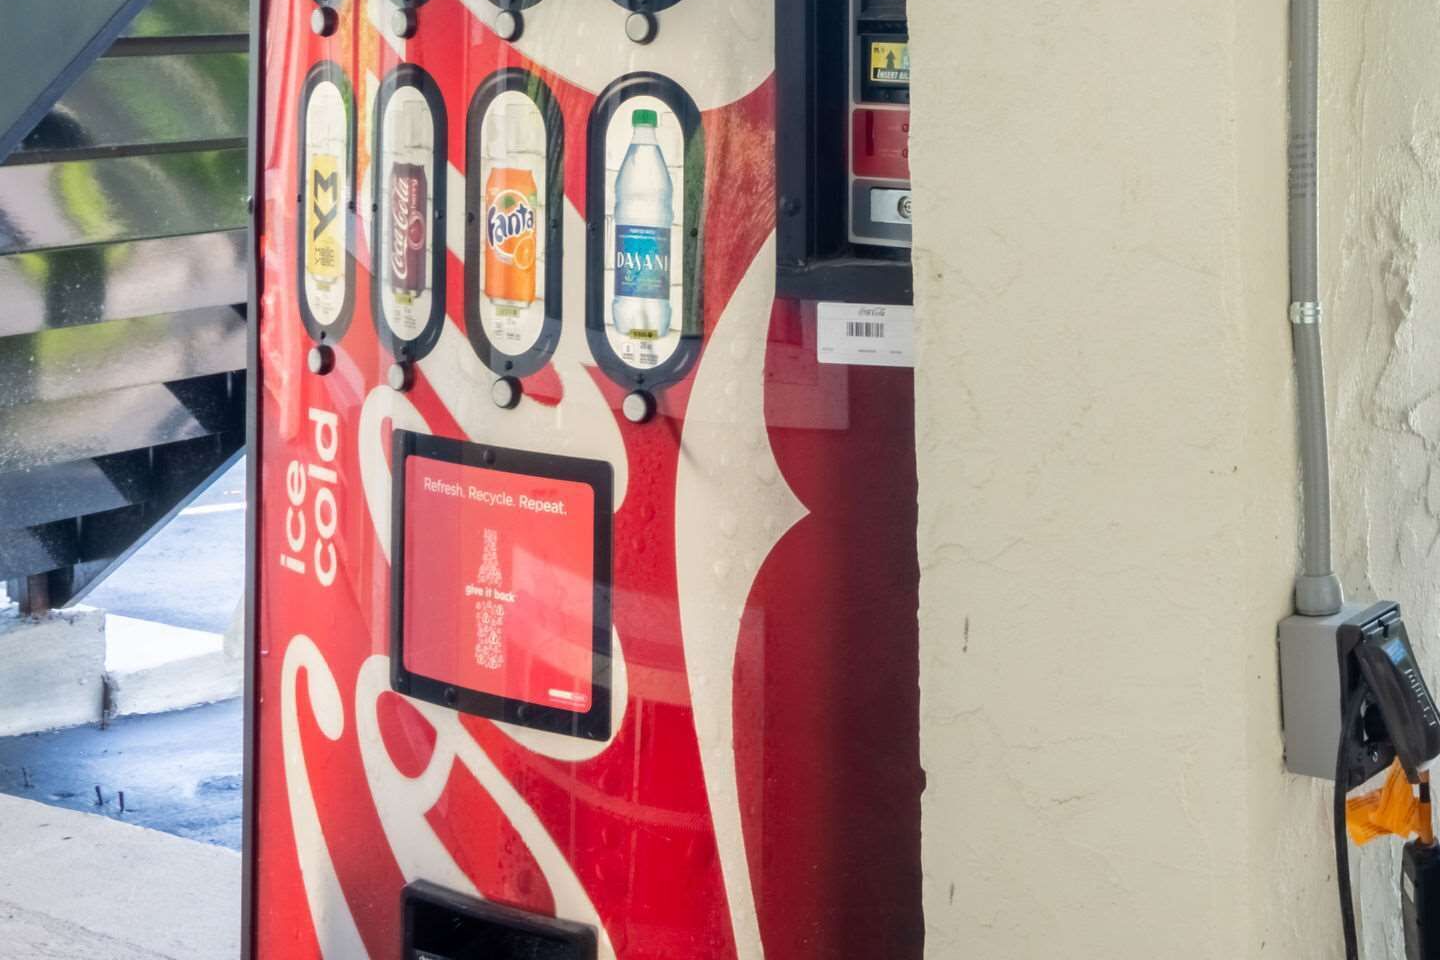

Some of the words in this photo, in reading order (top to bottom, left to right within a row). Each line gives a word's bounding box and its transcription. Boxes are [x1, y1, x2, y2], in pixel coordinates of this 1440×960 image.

[617, 252, 668, 272] DASANI
[281, 460, 307, 574] ice
[308, 407, 339, 587] cold
[468, 487, 516, 507] Recycle.
[519, 496, 567, 515] Repeat.
